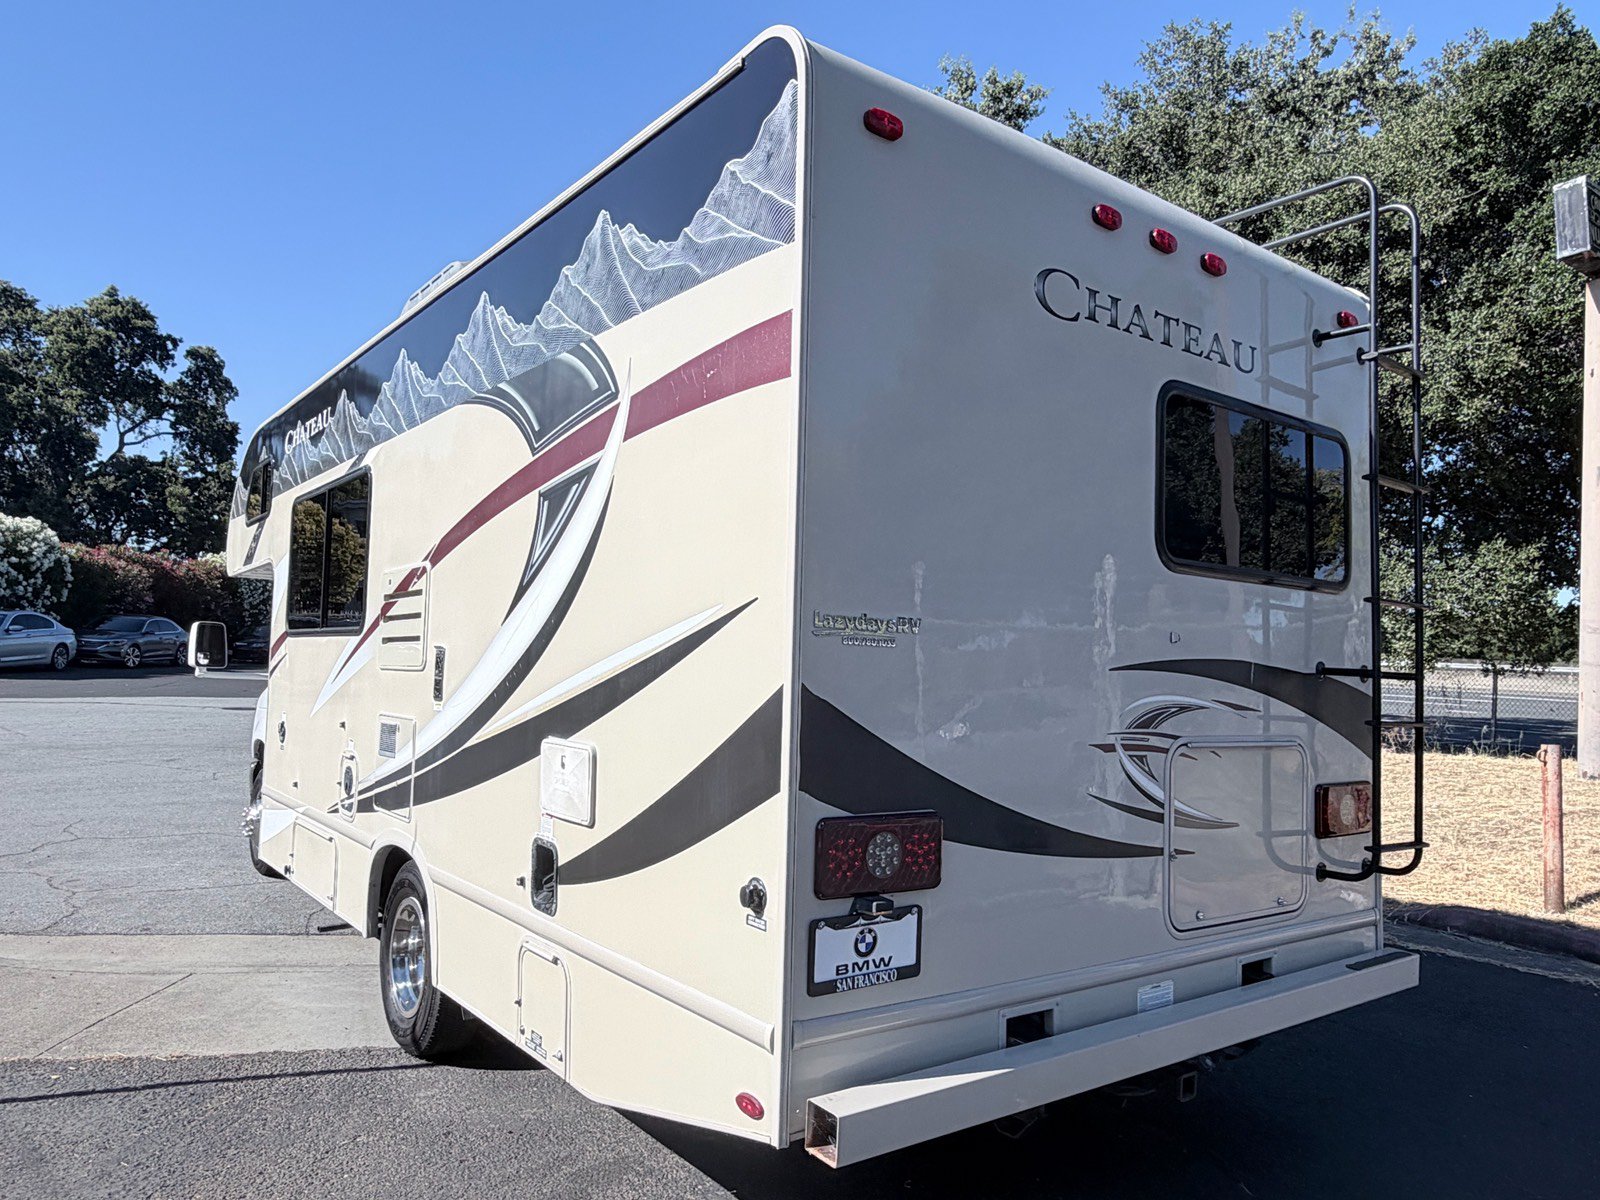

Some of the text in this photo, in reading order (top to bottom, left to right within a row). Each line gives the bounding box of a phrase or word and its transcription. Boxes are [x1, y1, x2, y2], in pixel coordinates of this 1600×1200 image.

[1033, 267, 1257, 374] CHATEAU
[284, 406, 332, 454] CHATEAU
[835, 955, 893, 976] BMW
[836, 968, 898, 993] SAN FRANCISCO
